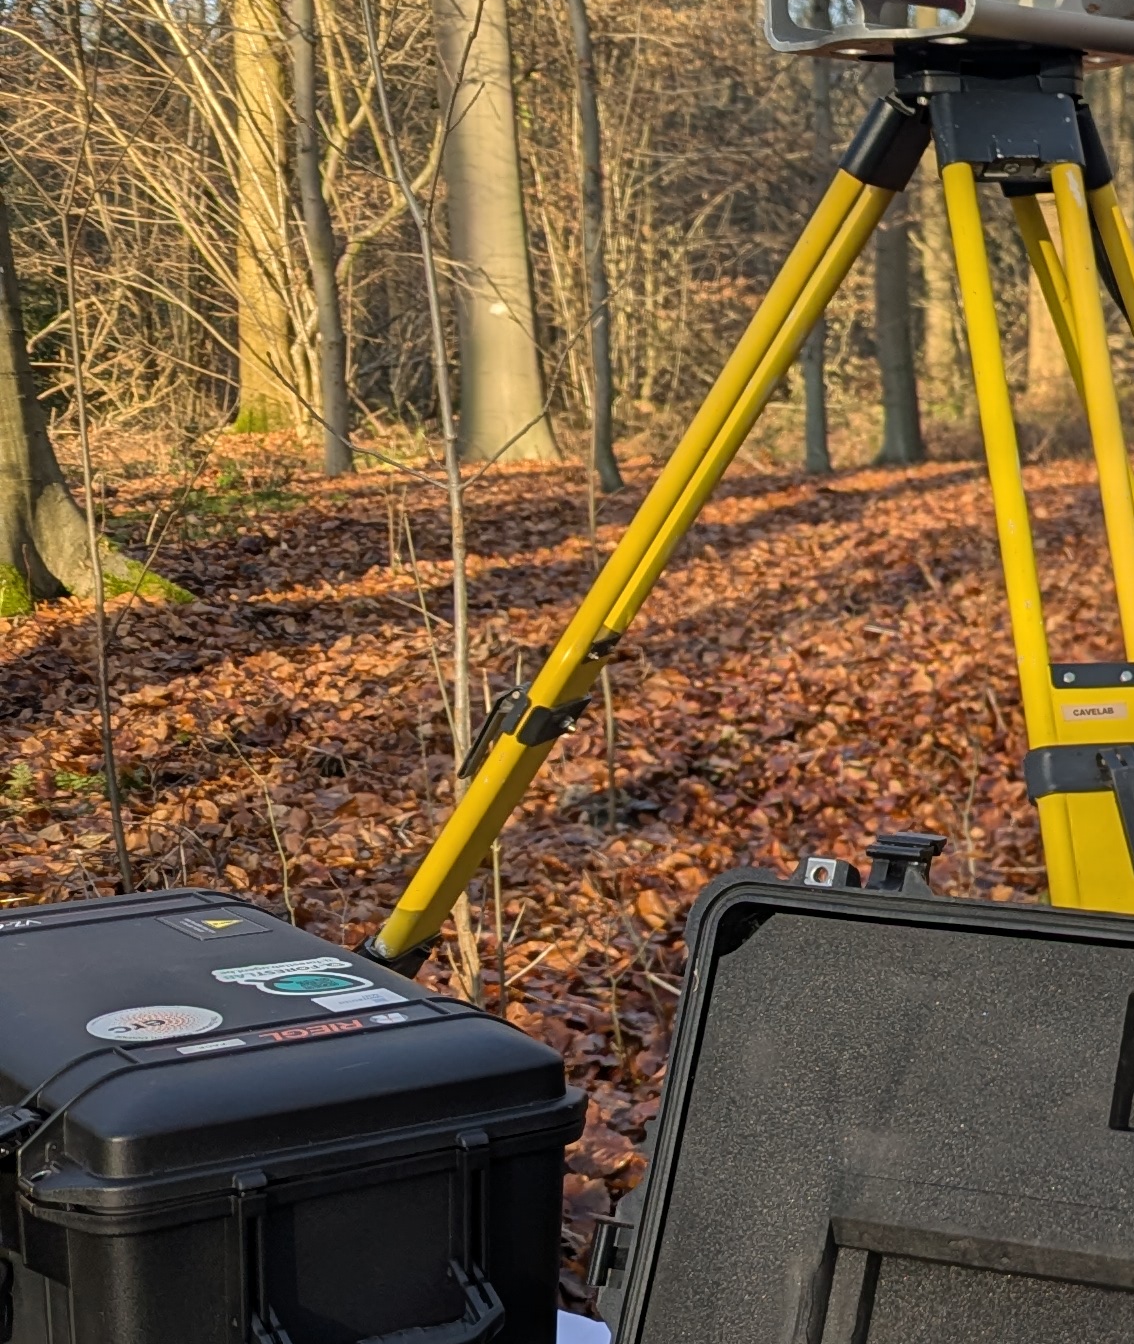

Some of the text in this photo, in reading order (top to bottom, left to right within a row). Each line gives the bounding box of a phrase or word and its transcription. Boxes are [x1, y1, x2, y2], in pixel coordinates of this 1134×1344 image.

[1073, 707, 1114, 716] CAVELAB
[107, 1019, 166, 1034] erc
[258, 1019, 364, 1041] RIEGL
